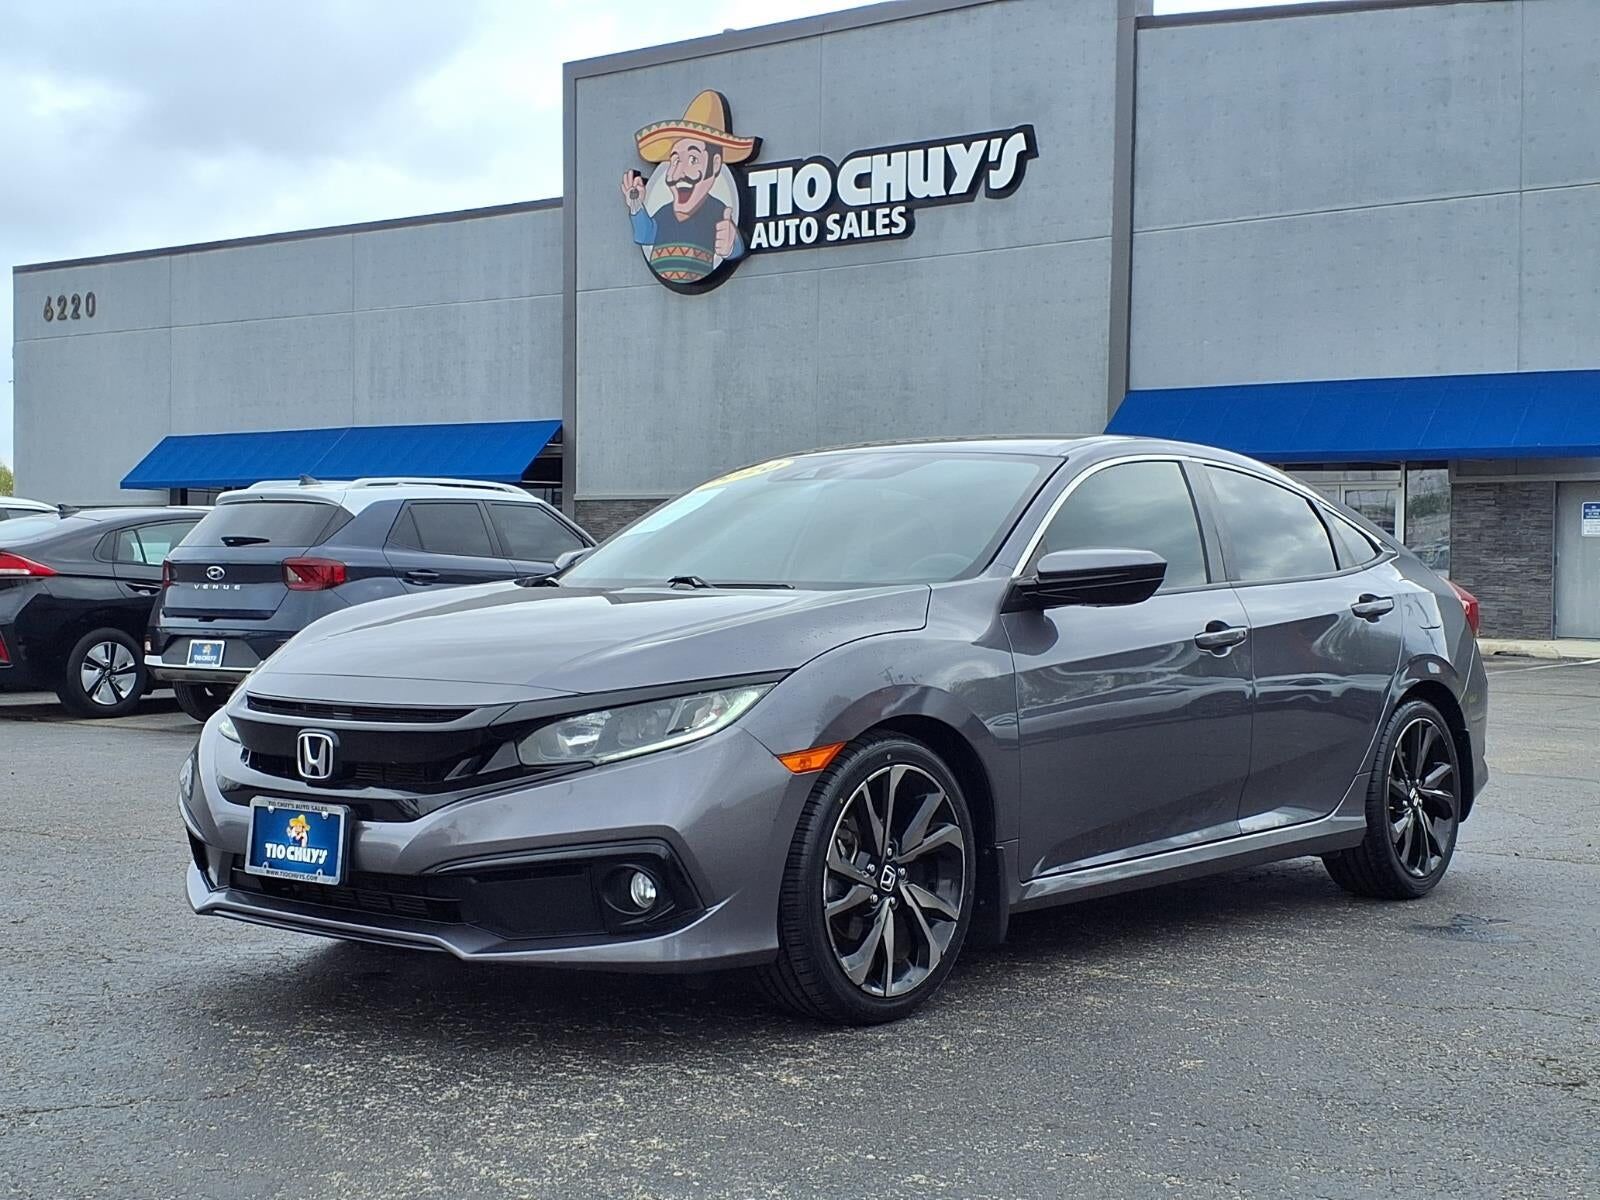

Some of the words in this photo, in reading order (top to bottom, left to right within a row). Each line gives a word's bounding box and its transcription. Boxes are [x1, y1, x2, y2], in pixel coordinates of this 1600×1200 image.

[748, 163, 832, 218] TIO
[837, 132, 1027, 206] CHUY'S
[750, 217, 818, 249] AUTO
[826, 206, 907, 241] SALES
[43, 291, 97, 322] 6220
[193, 583, 241, 591] VENUE
[265, 842, 286, 859] TIO
[286, 845, 328, 865] CHUY'S
